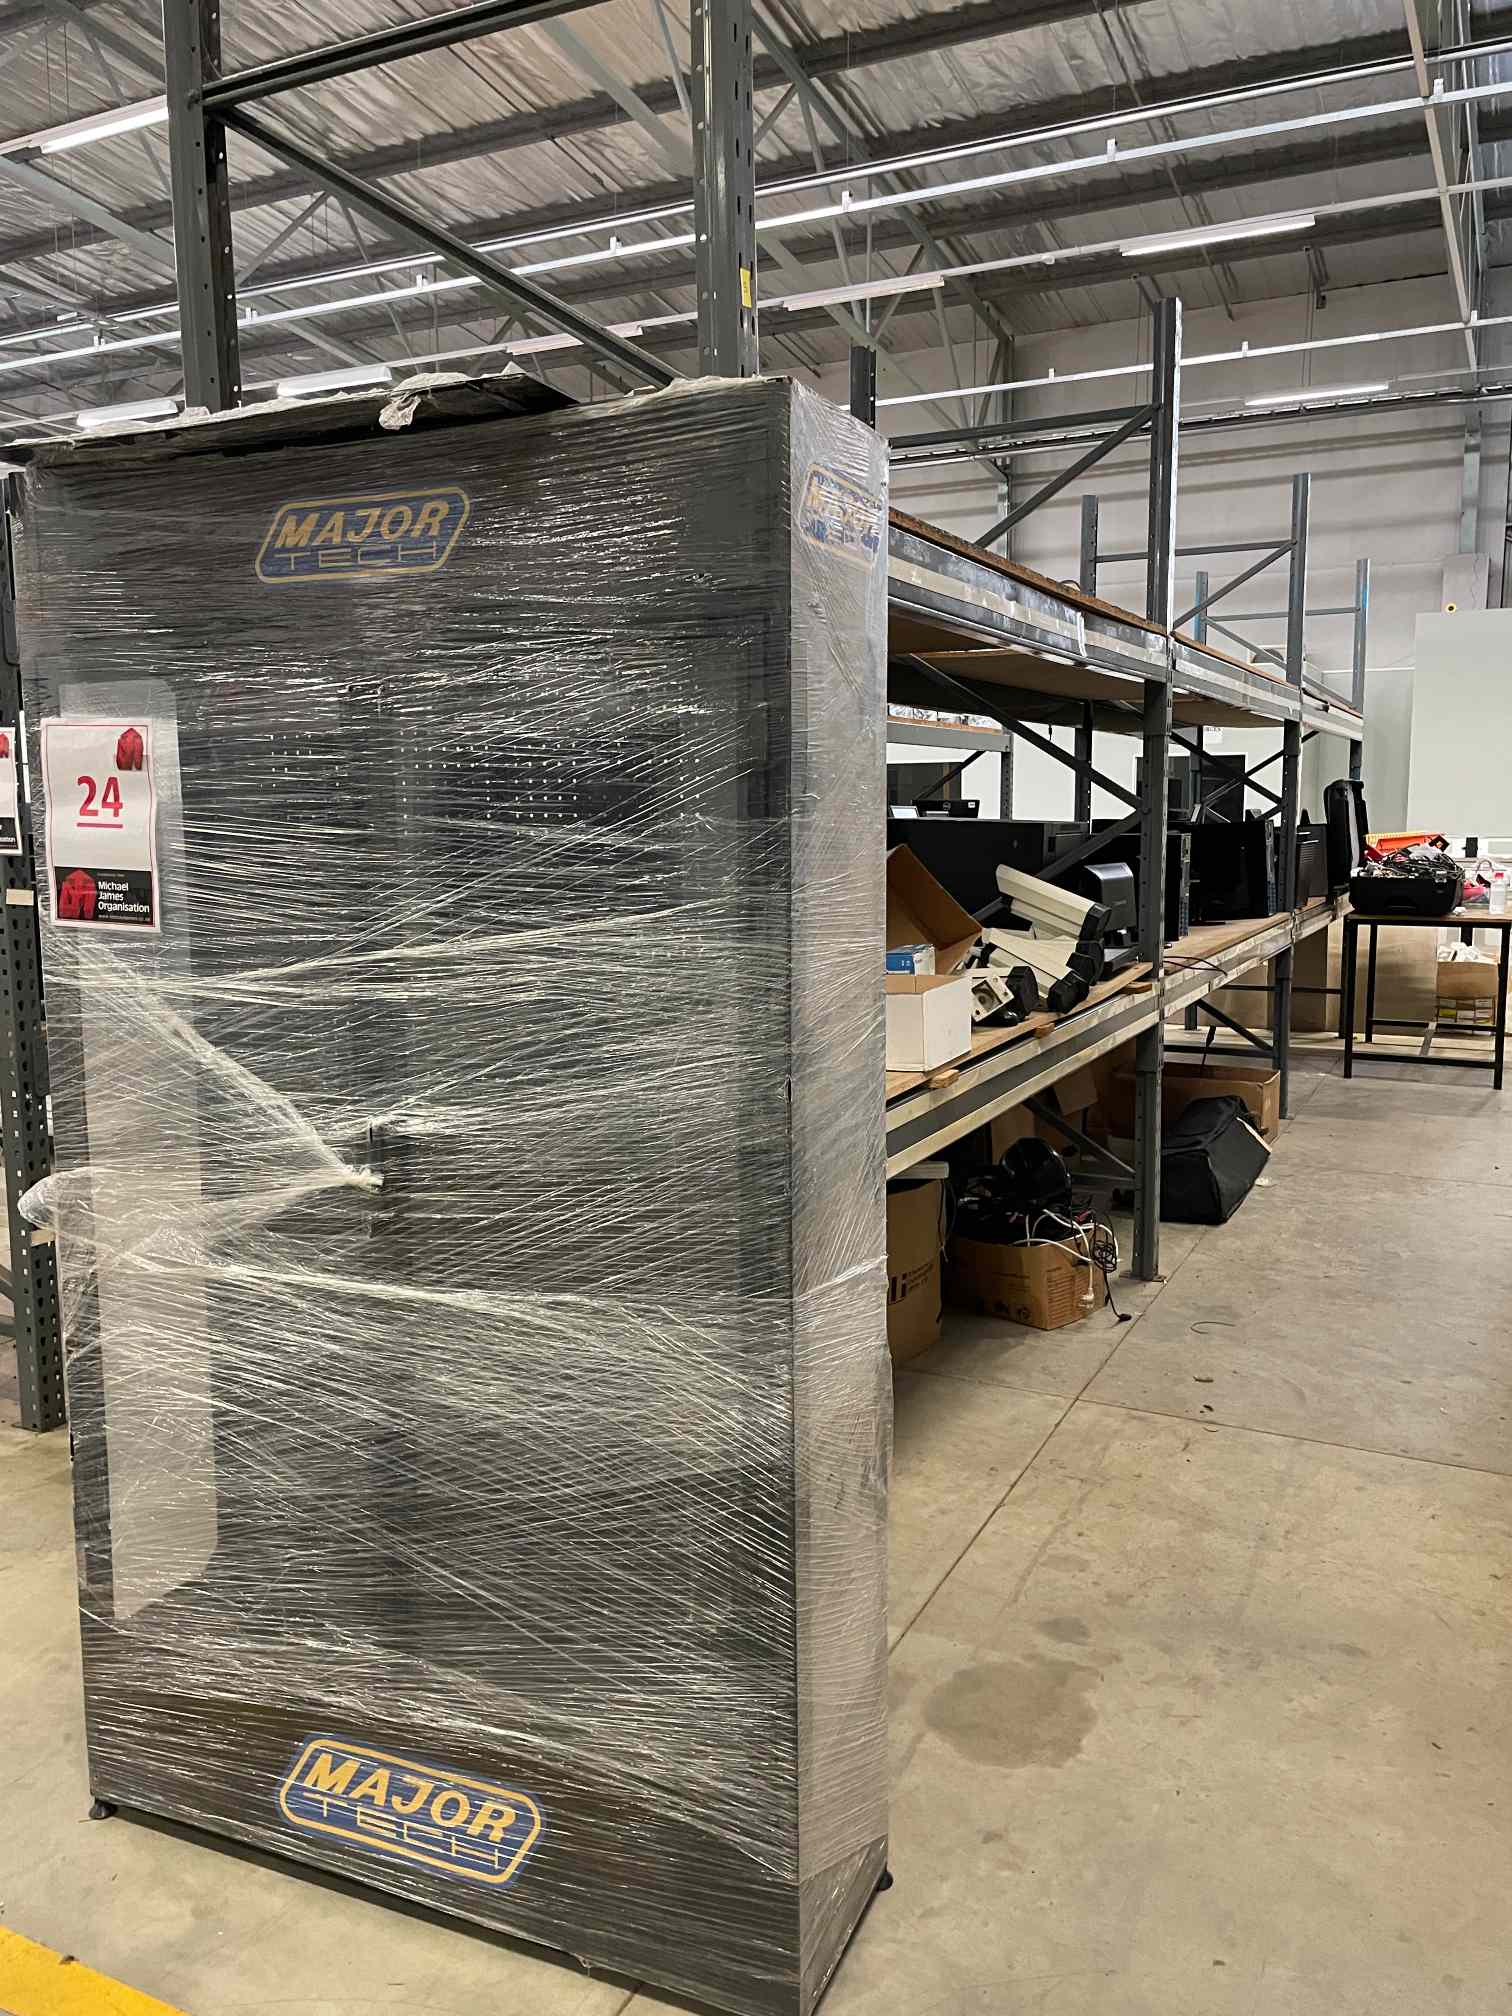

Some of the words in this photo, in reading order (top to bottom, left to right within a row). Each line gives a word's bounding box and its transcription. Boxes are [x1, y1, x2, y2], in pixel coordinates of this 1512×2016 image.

[274, 499, 450, 548] MAJOR
[273, 540, 437, 571] TECH
[77, 775, 123, 818] 24
[98, 881, 129, 892] Michael
[98, 891, 124, 901] James
[98, 900, 150, 913] Organisation
[303, 1752, 517, 1842] MAJOR
[303, 1792, 500, 1870] TECH
